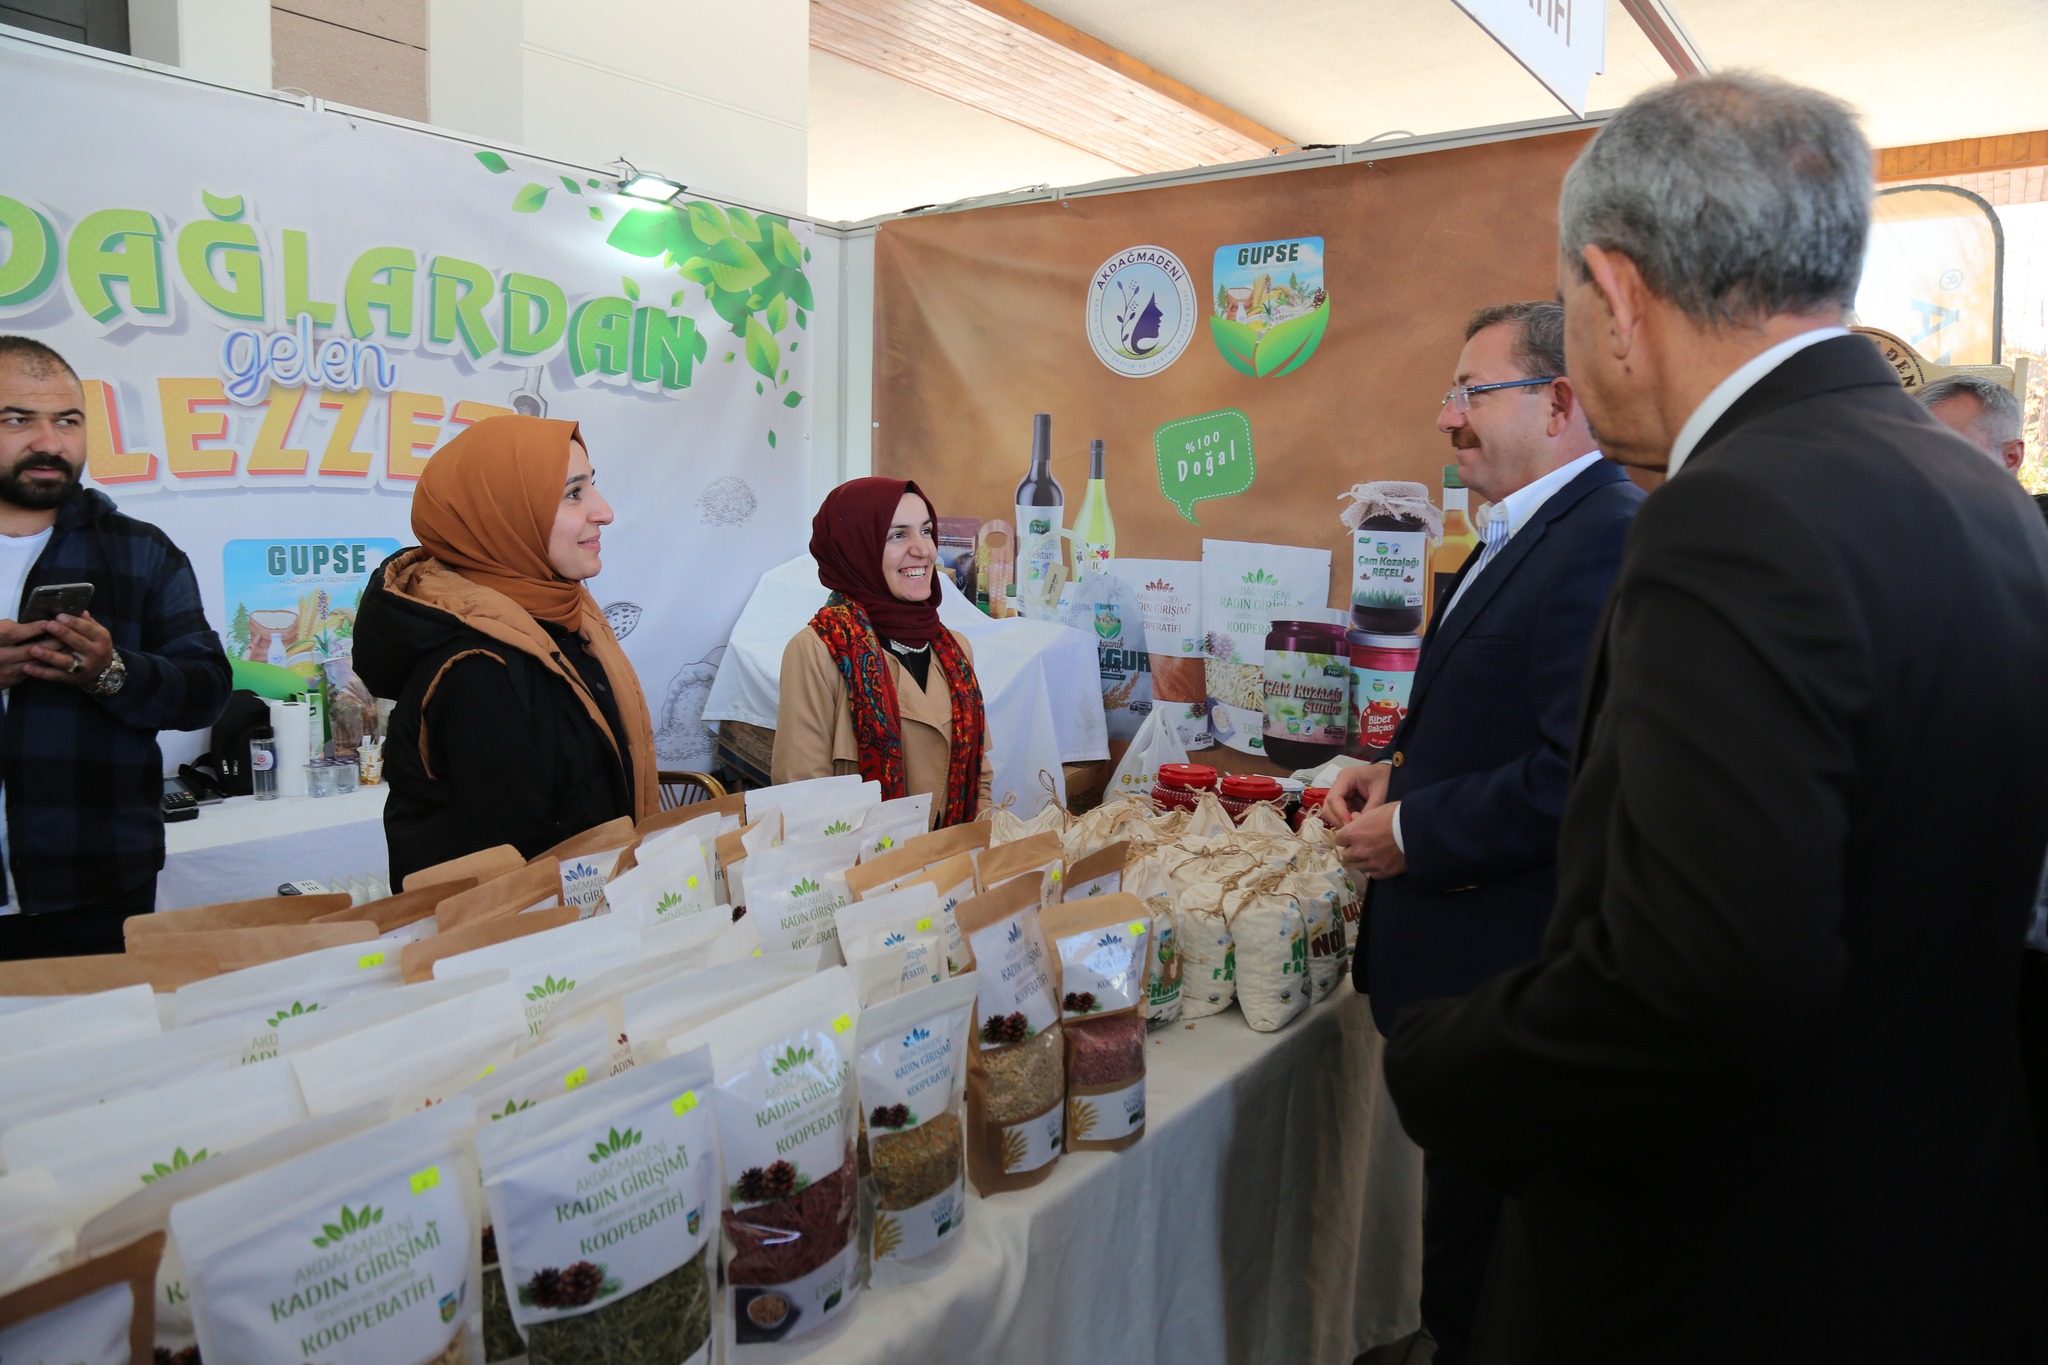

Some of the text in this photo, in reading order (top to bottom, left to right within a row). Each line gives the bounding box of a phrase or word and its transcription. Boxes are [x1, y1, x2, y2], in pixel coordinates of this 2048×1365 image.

[1096, 251, 1185, 290] AKDAĞMADENİ
[1237, 243, 1300, 266] GUPSE
[222, 315, 396, 399] gelen
[84, 376, 516, 485] LEZZE
[1185, 431, 1220, 454] %100
[1177, 439, 1235, 482] Doğal
[267, 544, 366, 576] GUPSE
[1358, 556, 1420, 569] Çam Kozalağı
[1371, 566, 1404, 579] REÇELİ
[1227, 621, 1272, 637] KOOPERA
[1243, 723, 1264, 738] ERİŞ
[1368, 715, 1393, 725] Biber
[781, 911, 809, 930] KADIN
[895, 1060, 919, 1080] KADIN
[756, 1093, 801, 1128] KADIN
[576, 1137, 668, 1195] AKDAĞMADENİ
[556, 1144, 689, 1224] KADIN GİRİŞİMİ
[580, 1190, 685, 1255] KOOPERATİFİ
[295, 1213, 414, 1285] AKDAĞMADENİ
[270, 1219, 441, 1323] KADIN GİRİŞİMİ
[301, 1272, 436, 1358] KOOPERATİFİ
